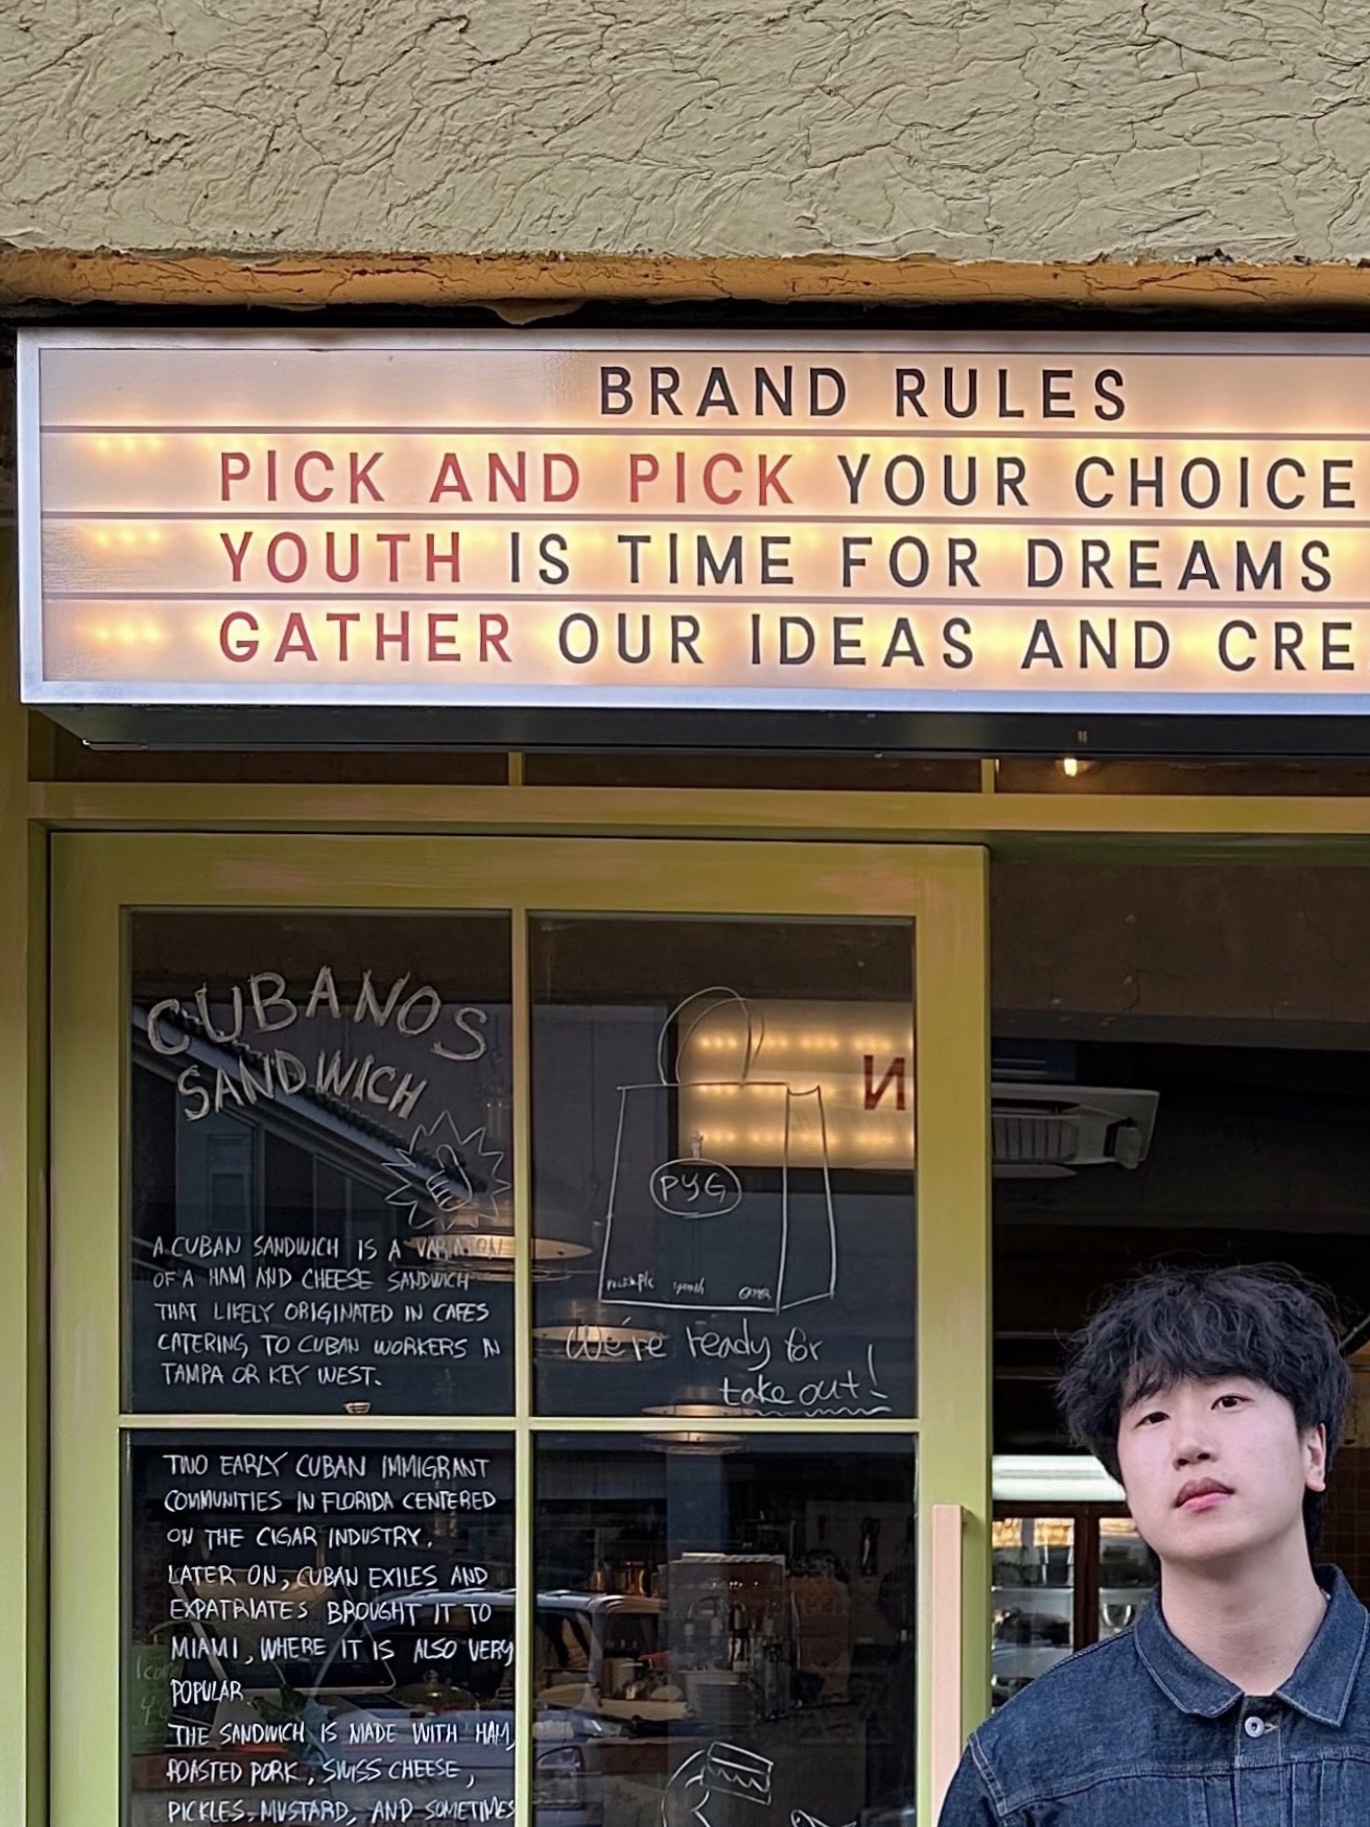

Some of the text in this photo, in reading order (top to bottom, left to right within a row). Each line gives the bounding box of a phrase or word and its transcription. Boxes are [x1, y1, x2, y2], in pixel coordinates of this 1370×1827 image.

[599, 365, 1127, 421] BRAND RULES
[220, 450, 1358, 511] PICK AND PICK YOUR CHOICE
[220, 531, 1334, 593] YOUTH IS TIME FOR DREAMS
[219, 609, 513, 664] GATHER
[558, 612, 705, 666] OUR
[751, 614, 975, 670] IDEAS
[1020, 617, 1172, 670] AND
[147, 965, 487, 1061] CUBANOS
[177, 1048, 429, 1122] SANDWICH
[153, 1235, 401, 1262] A CUBAN SANDWICH IS A
[153, 1265, 470, 1292] OF A HAM AND CHEESE SANDWICH
[154, 1301, 490, 1325] THAT LIKELY ORIGINATED IN CAFES
[158, 1332, 502, 1359] CATERING TO CUBAN WORKERS IN
[565, 1316, 824, 1371] We're ready for
[161, 1362, 383, 1387] TAMPA OR KEY WEST.
[718, 1374, 794, 1406] take
[162, 1451, 491, 1480] TWO EARLY CUBAN IMMIGRANT
[164, 1489, 497, 1513] COMMUNITIES IN FLORIDA CENTERED
[167, 1527, 194, 1547] ON
[204, 1527, 246, 1550] THE
[256, 1526, 319, 1548] CIGAR
[168, 1564, 237, 1586] LATER
[296, 1565, 359, 1588] CUBAN
[368, 1565, 438, 1588] EXILES
[450, 1565, 489, 1587] AND
[170, 1597, 492, 1627] EXPATRIATES BROUGHT IT TO
[260, 1636, 327, 1662] WHERE
[342, 1638, 363, 1661] IT
[373, 1639, 396, 1661] IS
[413, 1637, 458, 1664] ALSO
[468, 1638, 515, 1667] VERY
[167, 1722, 210, 1747] THE
[219, 1721, 305, 1745] SANDWICH
[321, 1721, 338, 1743] IS
[350, 1722, 398, 1745] MADE
[412, 1722, 458, 1745] WITH
[166, 1758, 243, 1784] ROASTED
[322, 1757, 383, 1784] SWISS
[371, 1797, 414, 1824] AND
[425, 1796, 516, 1824] SOMETIMES
